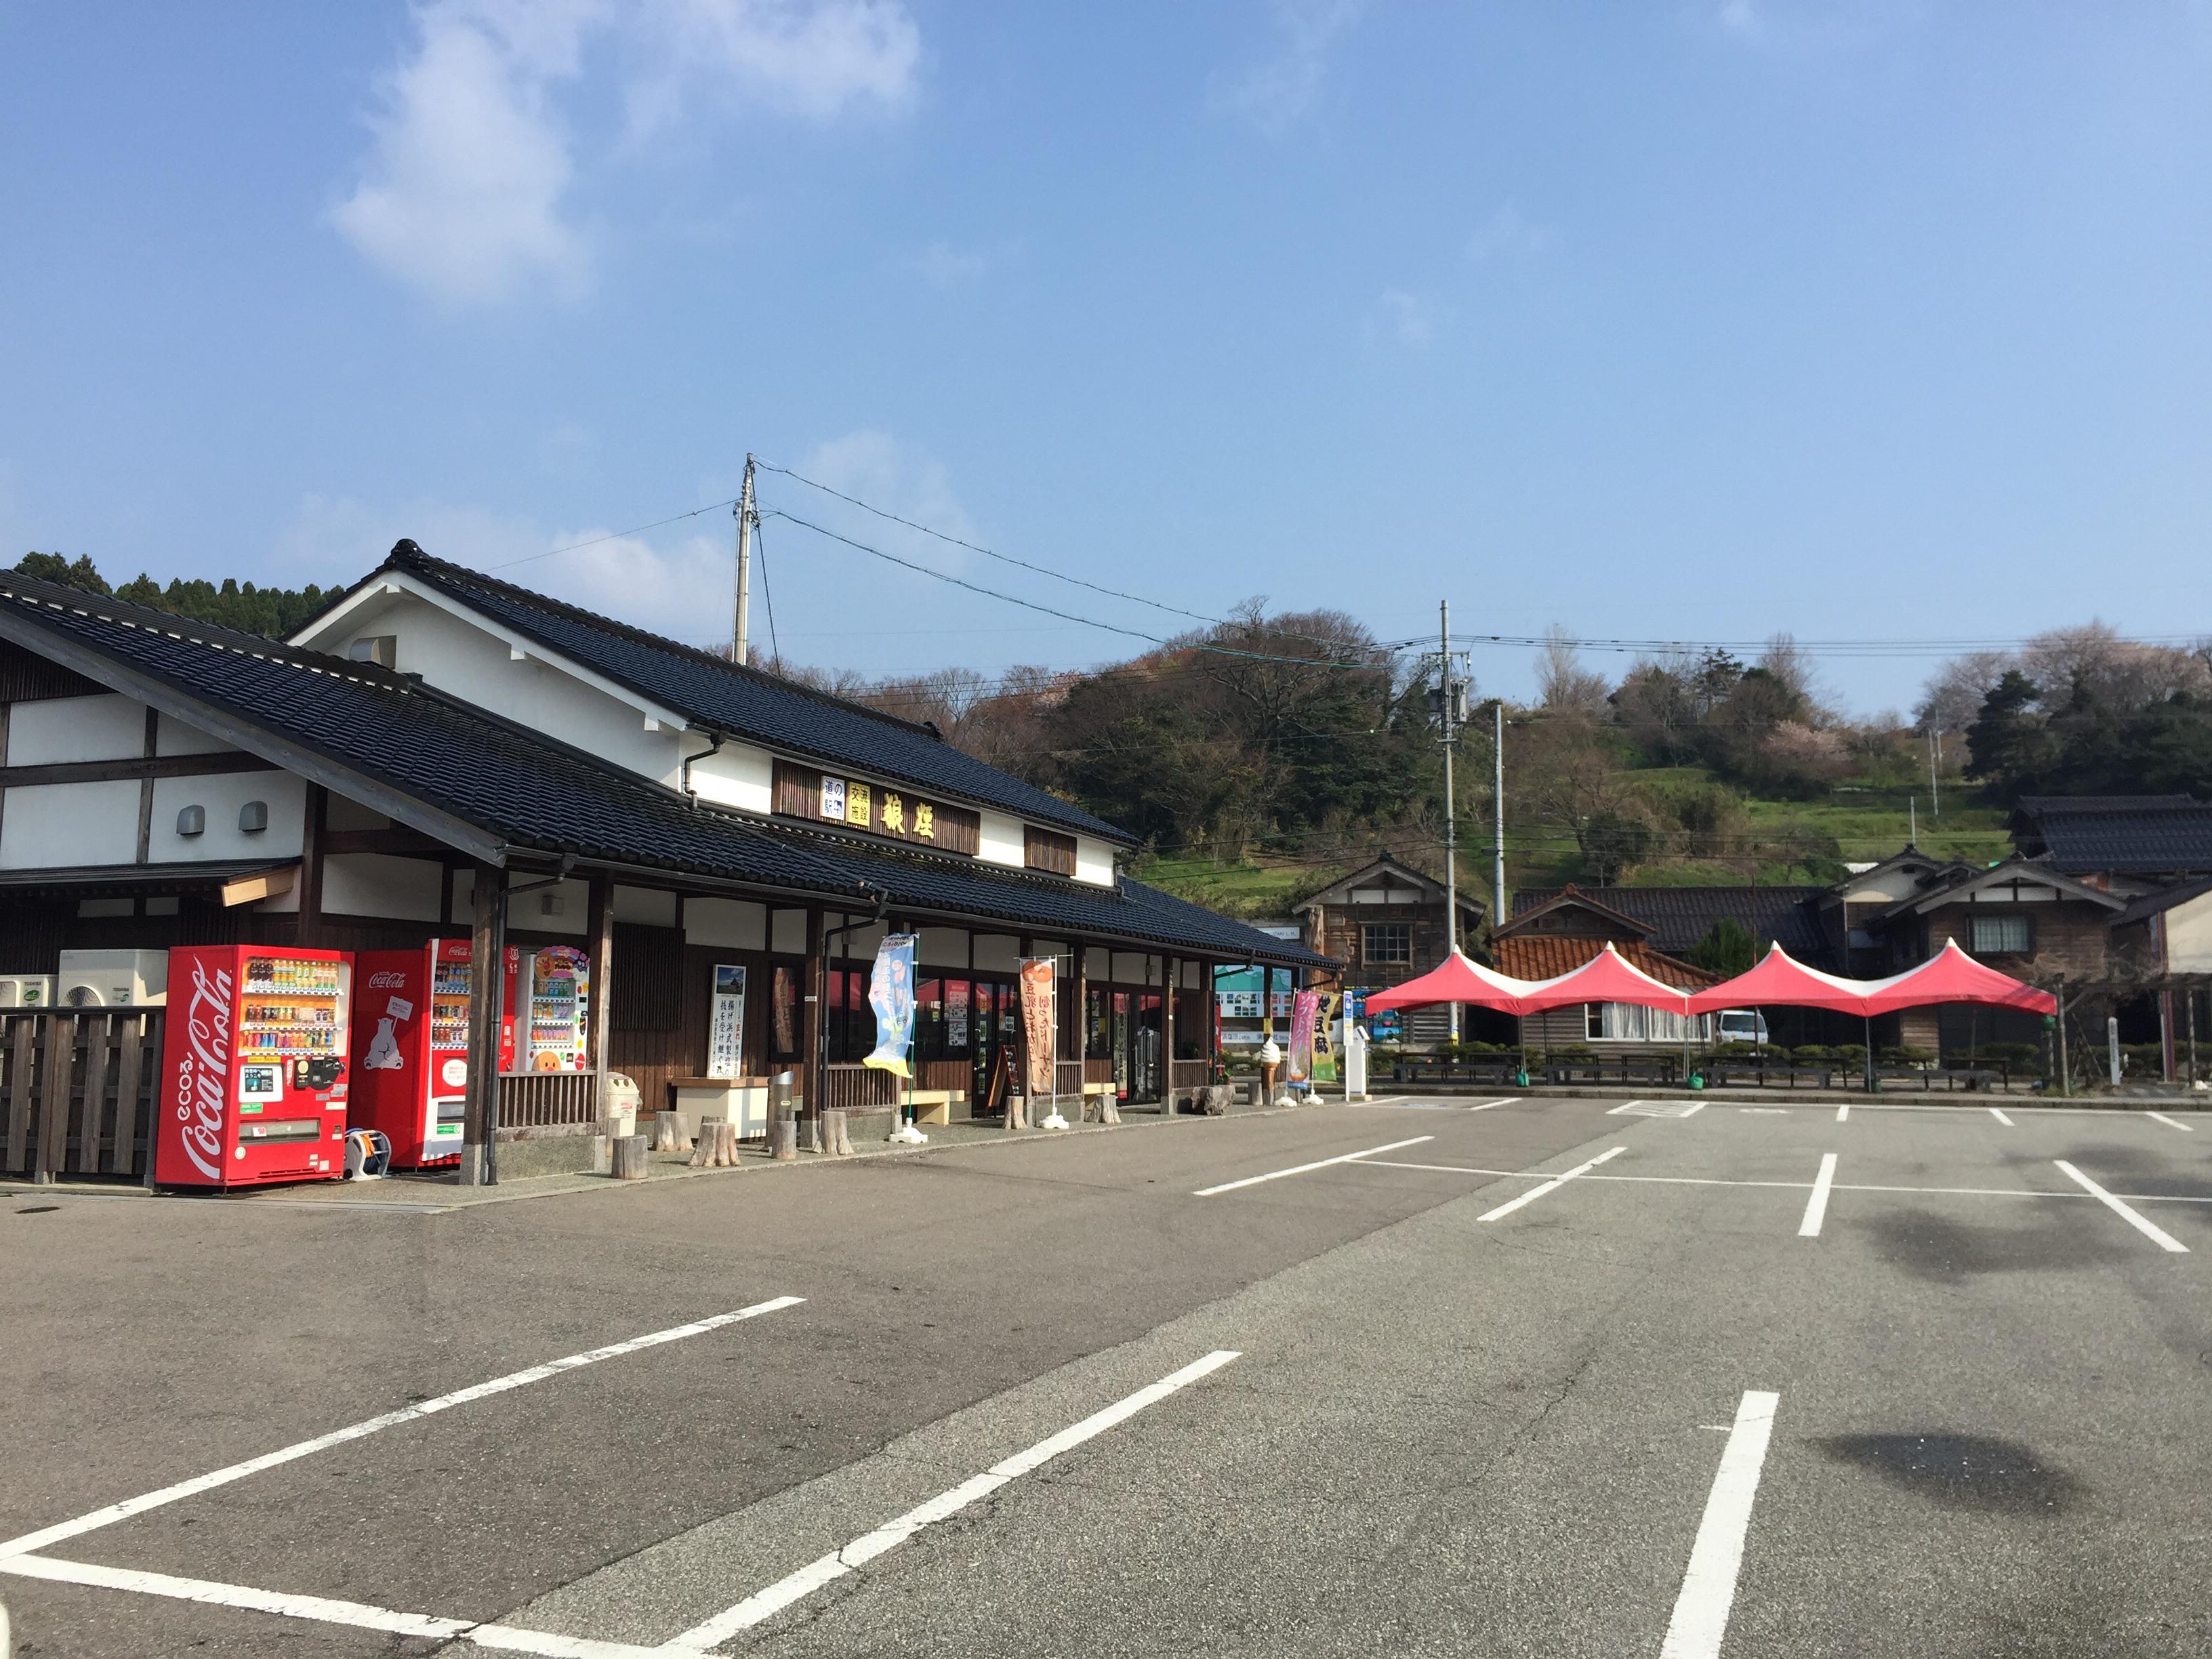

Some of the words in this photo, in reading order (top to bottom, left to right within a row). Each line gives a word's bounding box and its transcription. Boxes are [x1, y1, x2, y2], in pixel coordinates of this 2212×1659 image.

[825, 780, 842, 796] 道の
[851, 786, 868, 803] 交流
[824, 799, 833, 813] 駅
[851, 804, 868, 821] 施設
[369, 972, 407, 989] Coca-Cola
[182, 954, 232, 1179] Coca-Cola
